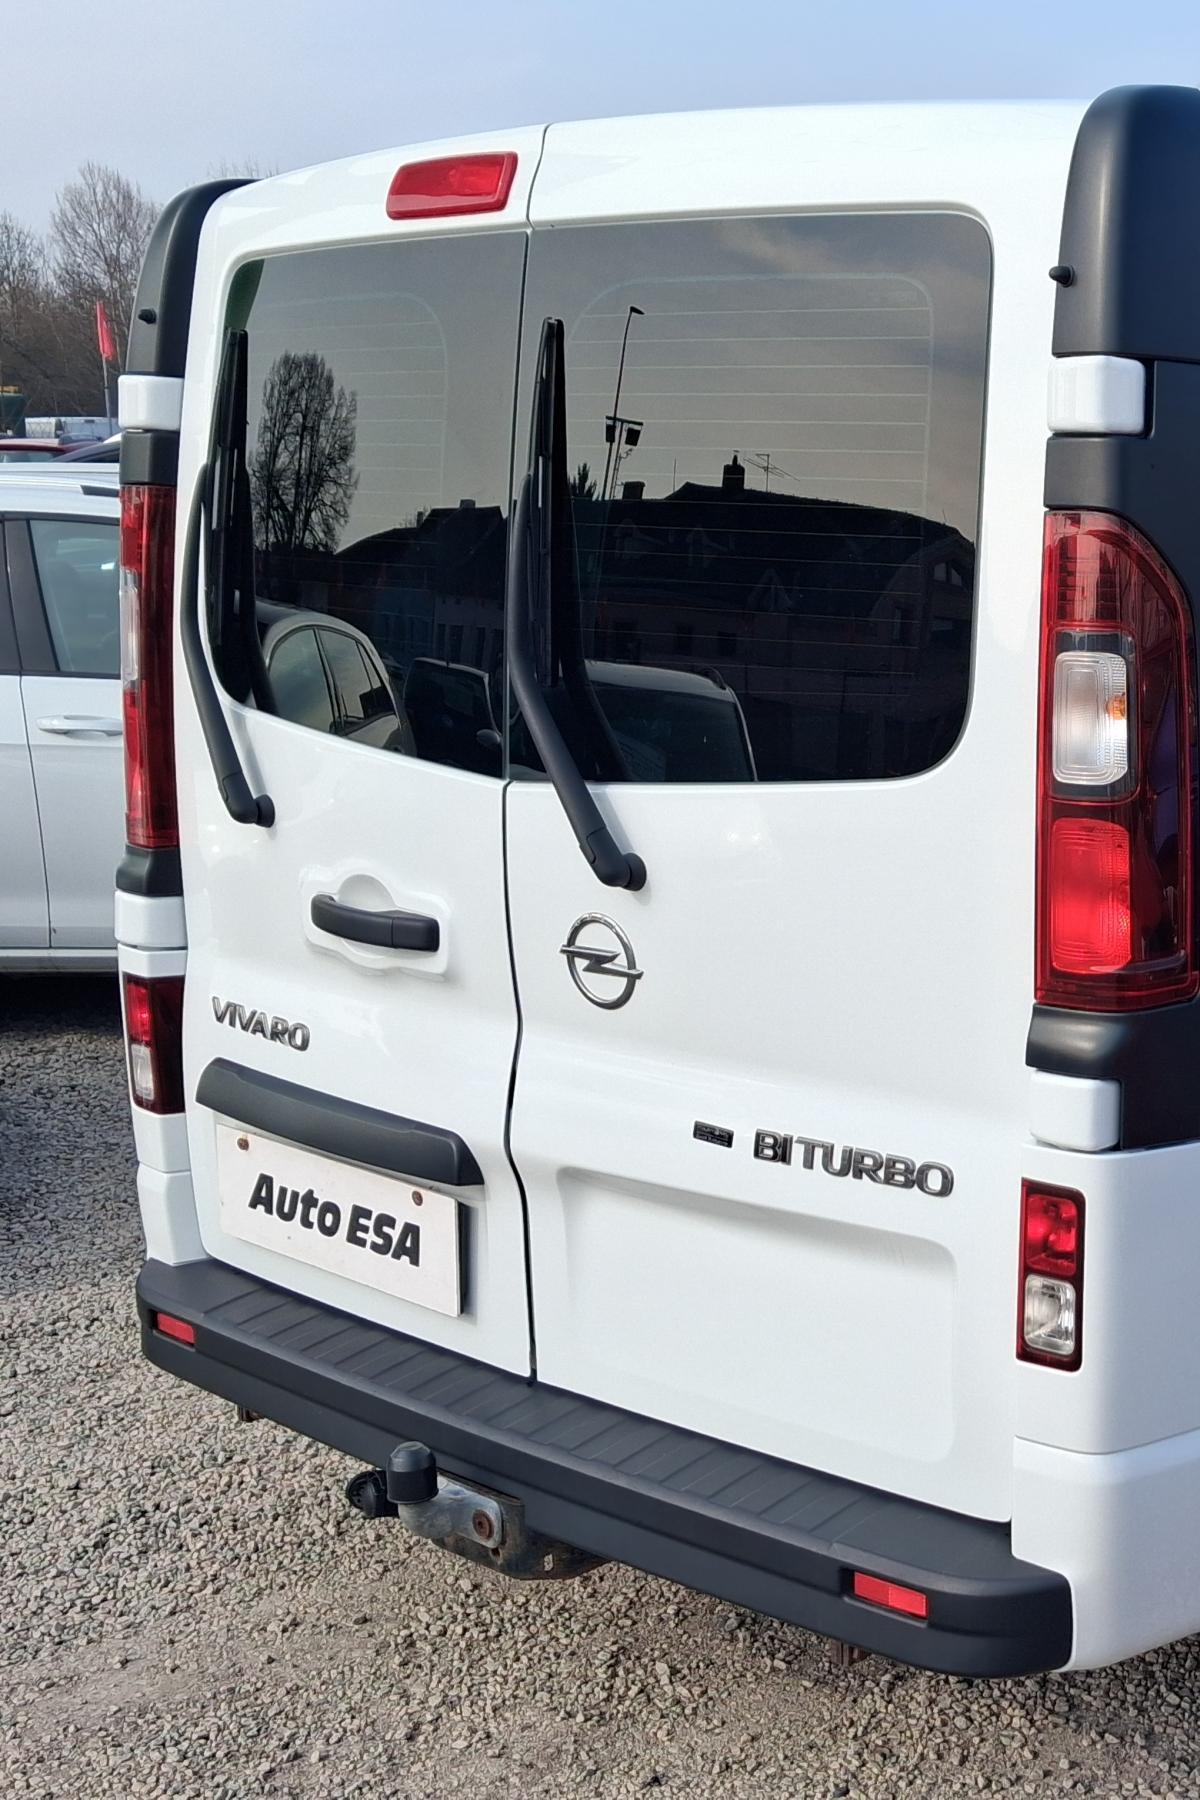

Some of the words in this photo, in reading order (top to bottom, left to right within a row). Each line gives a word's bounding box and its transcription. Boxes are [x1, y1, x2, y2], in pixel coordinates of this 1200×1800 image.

[211, 996, 310, 1051] VIVARO
[248, 1173, 341, 1237] Auto
[346, 1204, 420, 1267] ESA
